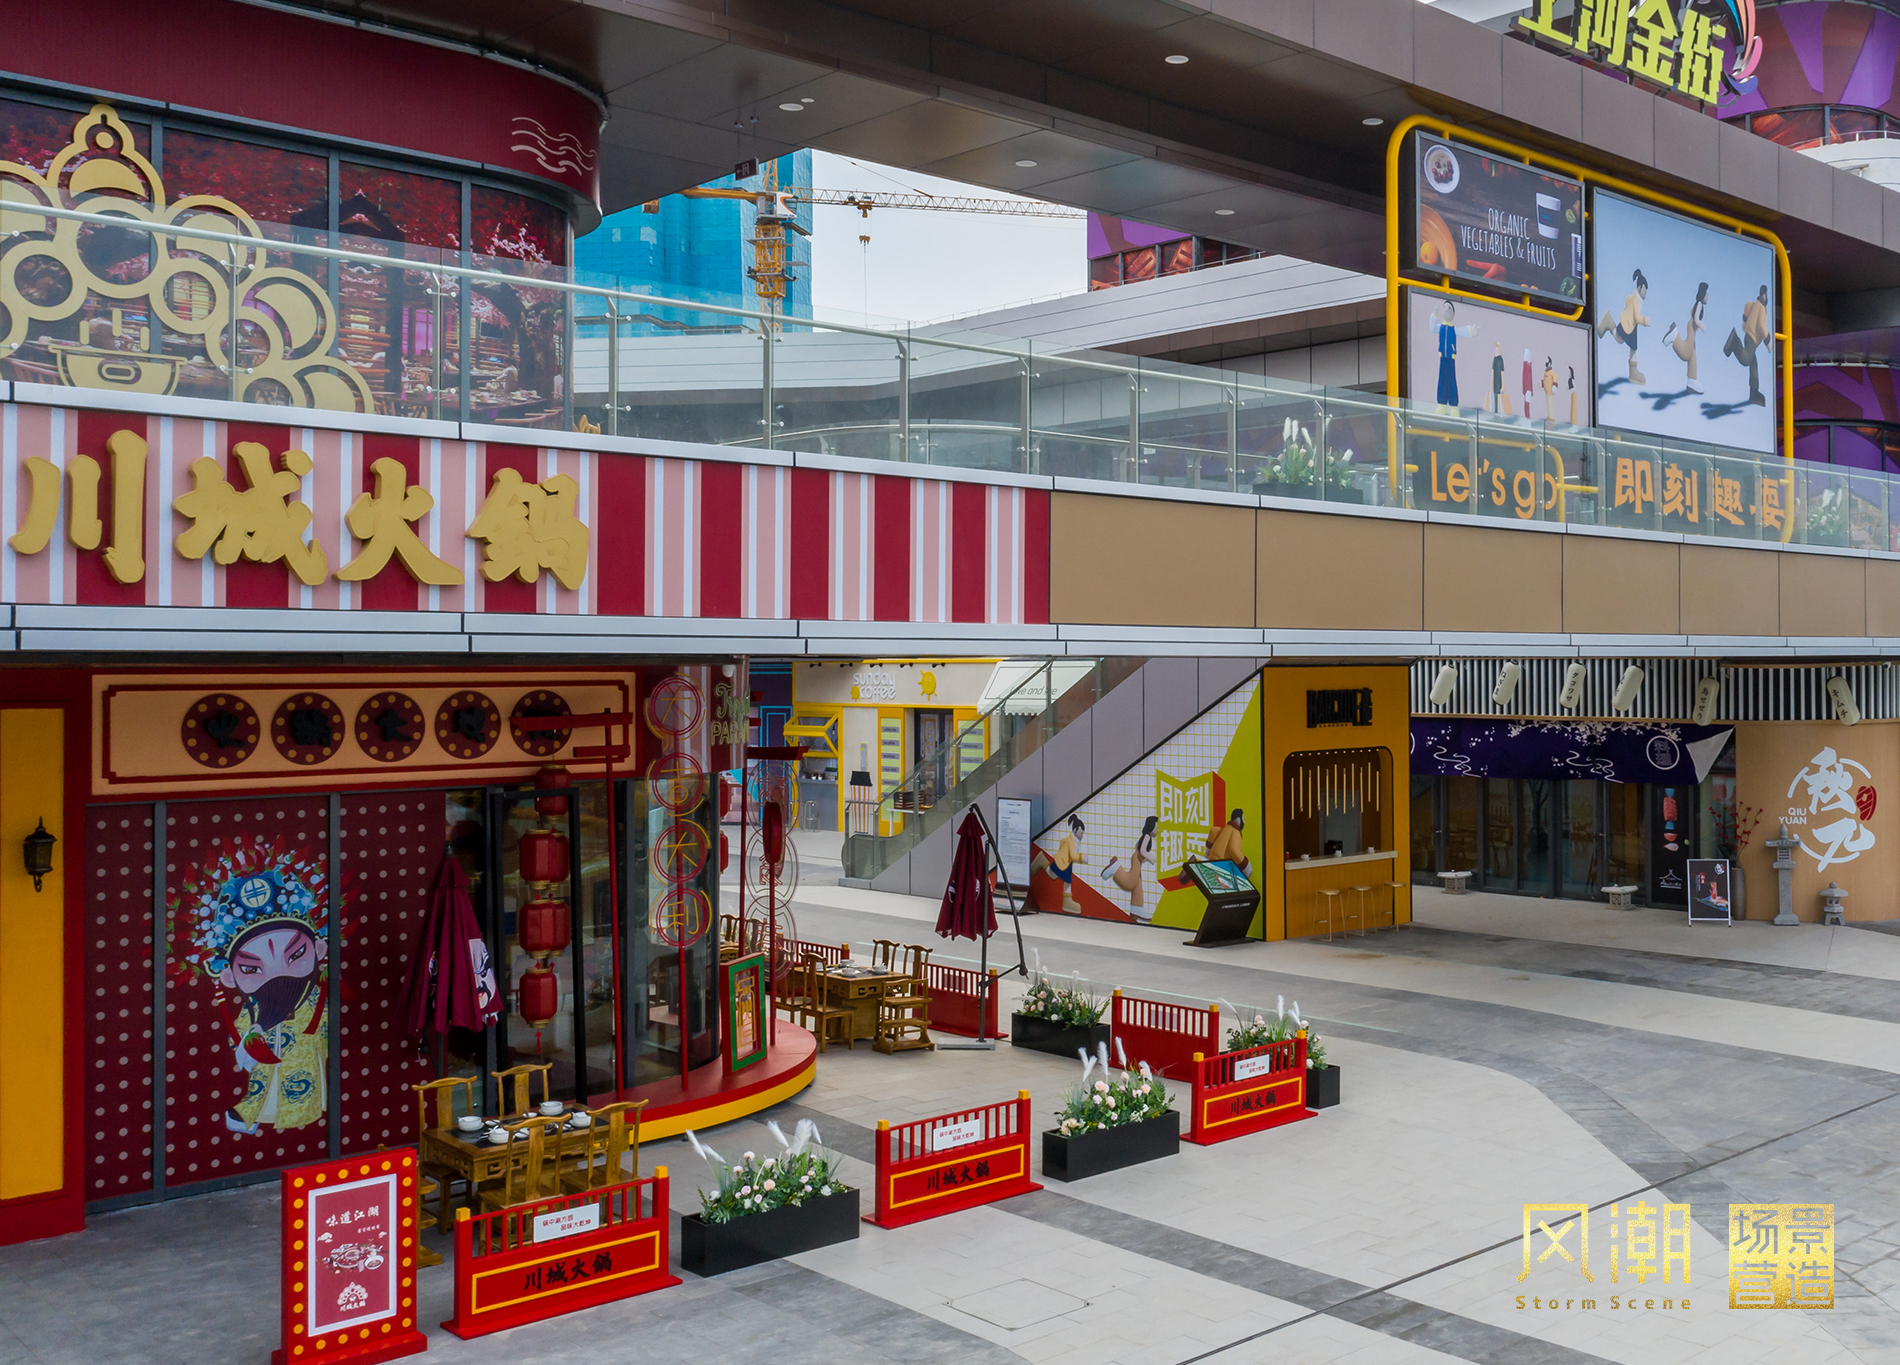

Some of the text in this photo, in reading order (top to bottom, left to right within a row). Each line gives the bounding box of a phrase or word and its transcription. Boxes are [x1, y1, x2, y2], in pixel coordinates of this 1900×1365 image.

[1488, 208, 1530, 240] ORGANIC
[1460, 225, 1514, 260] VEGETABLES
[1516, 238, 1525, 259] &
[1527, 242, 1556, 271] FRUITS
[853, 668, 896, 686] sunday
[860, 685, 896, 703] coffee
[1027, 686, 1045, 695] and
[1832, 688, 1849, 719] キムチ
[1160, 780, 1210, 827] 即刻
[1788, 807, 1808, 816] QIU
[1779, 816, 1808, 825] YUAN
[325, 1205, 379, 1227] 味道江湖
